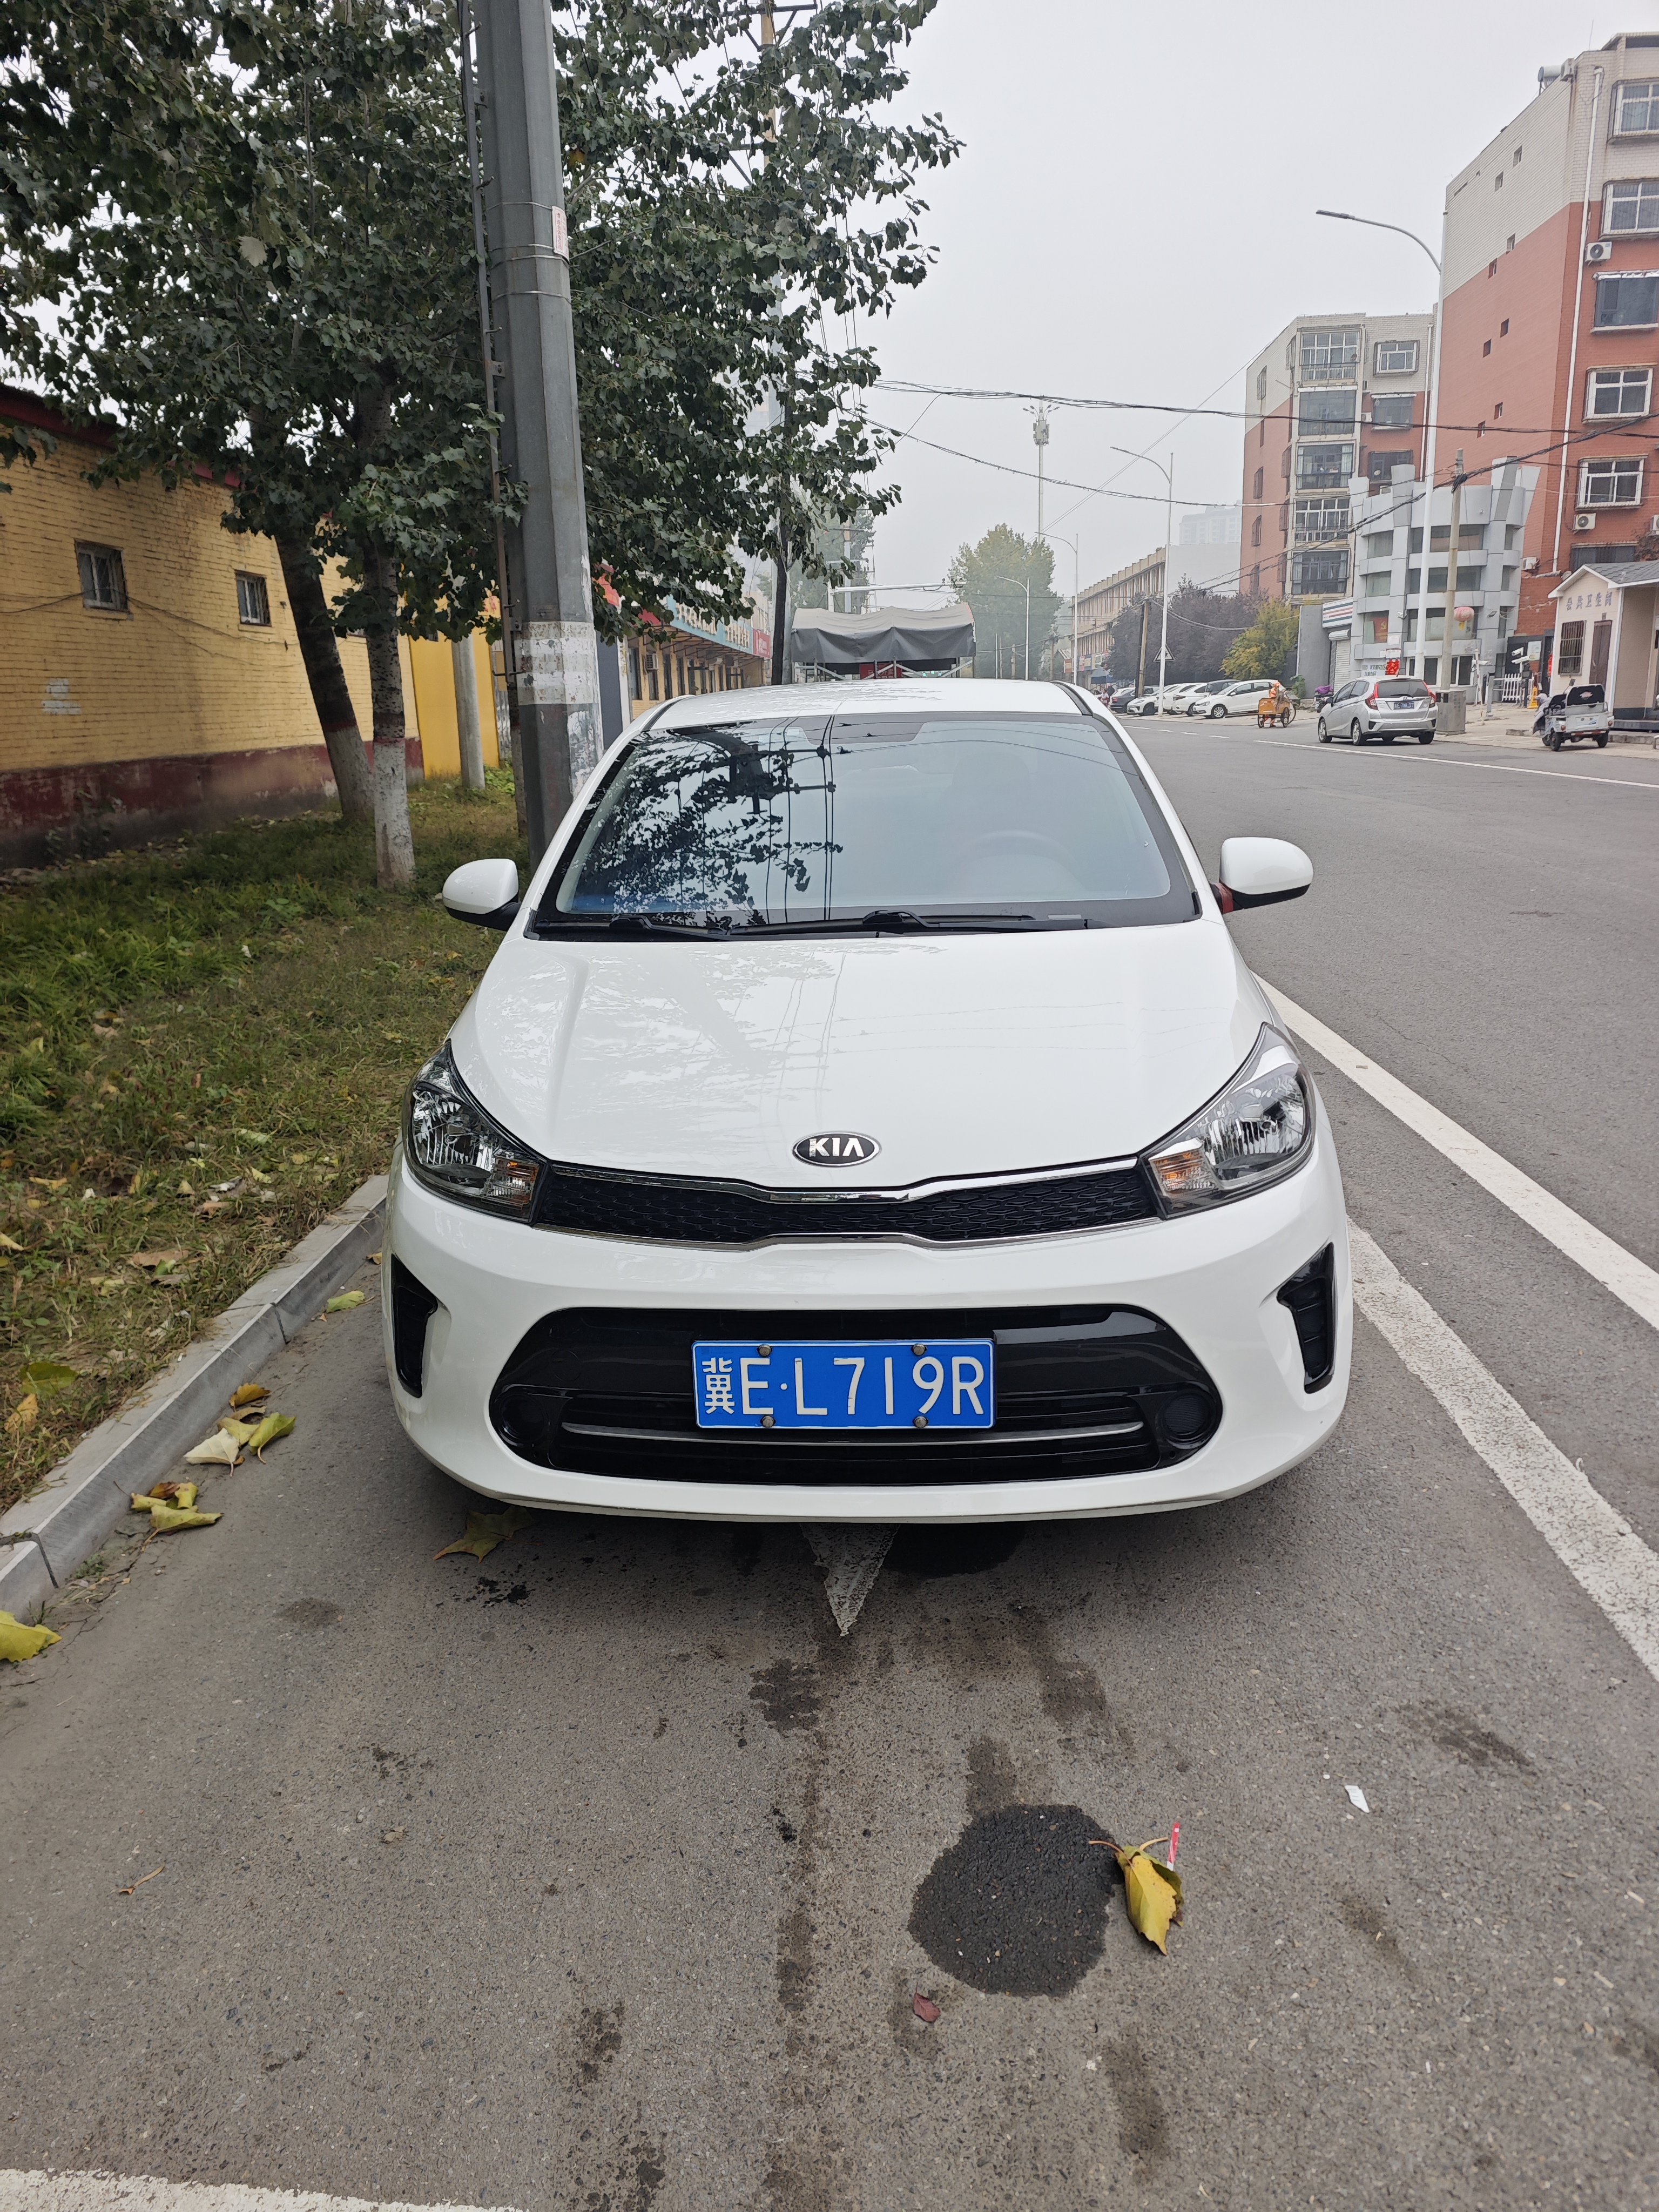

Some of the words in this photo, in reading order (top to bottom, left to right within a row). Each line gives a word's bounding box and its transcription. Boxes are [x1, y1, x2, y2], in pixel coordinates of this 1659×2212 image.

[1566, 591, 1613, 611] 公共卫生间
[809, 1137, 864, 1157] KIA
